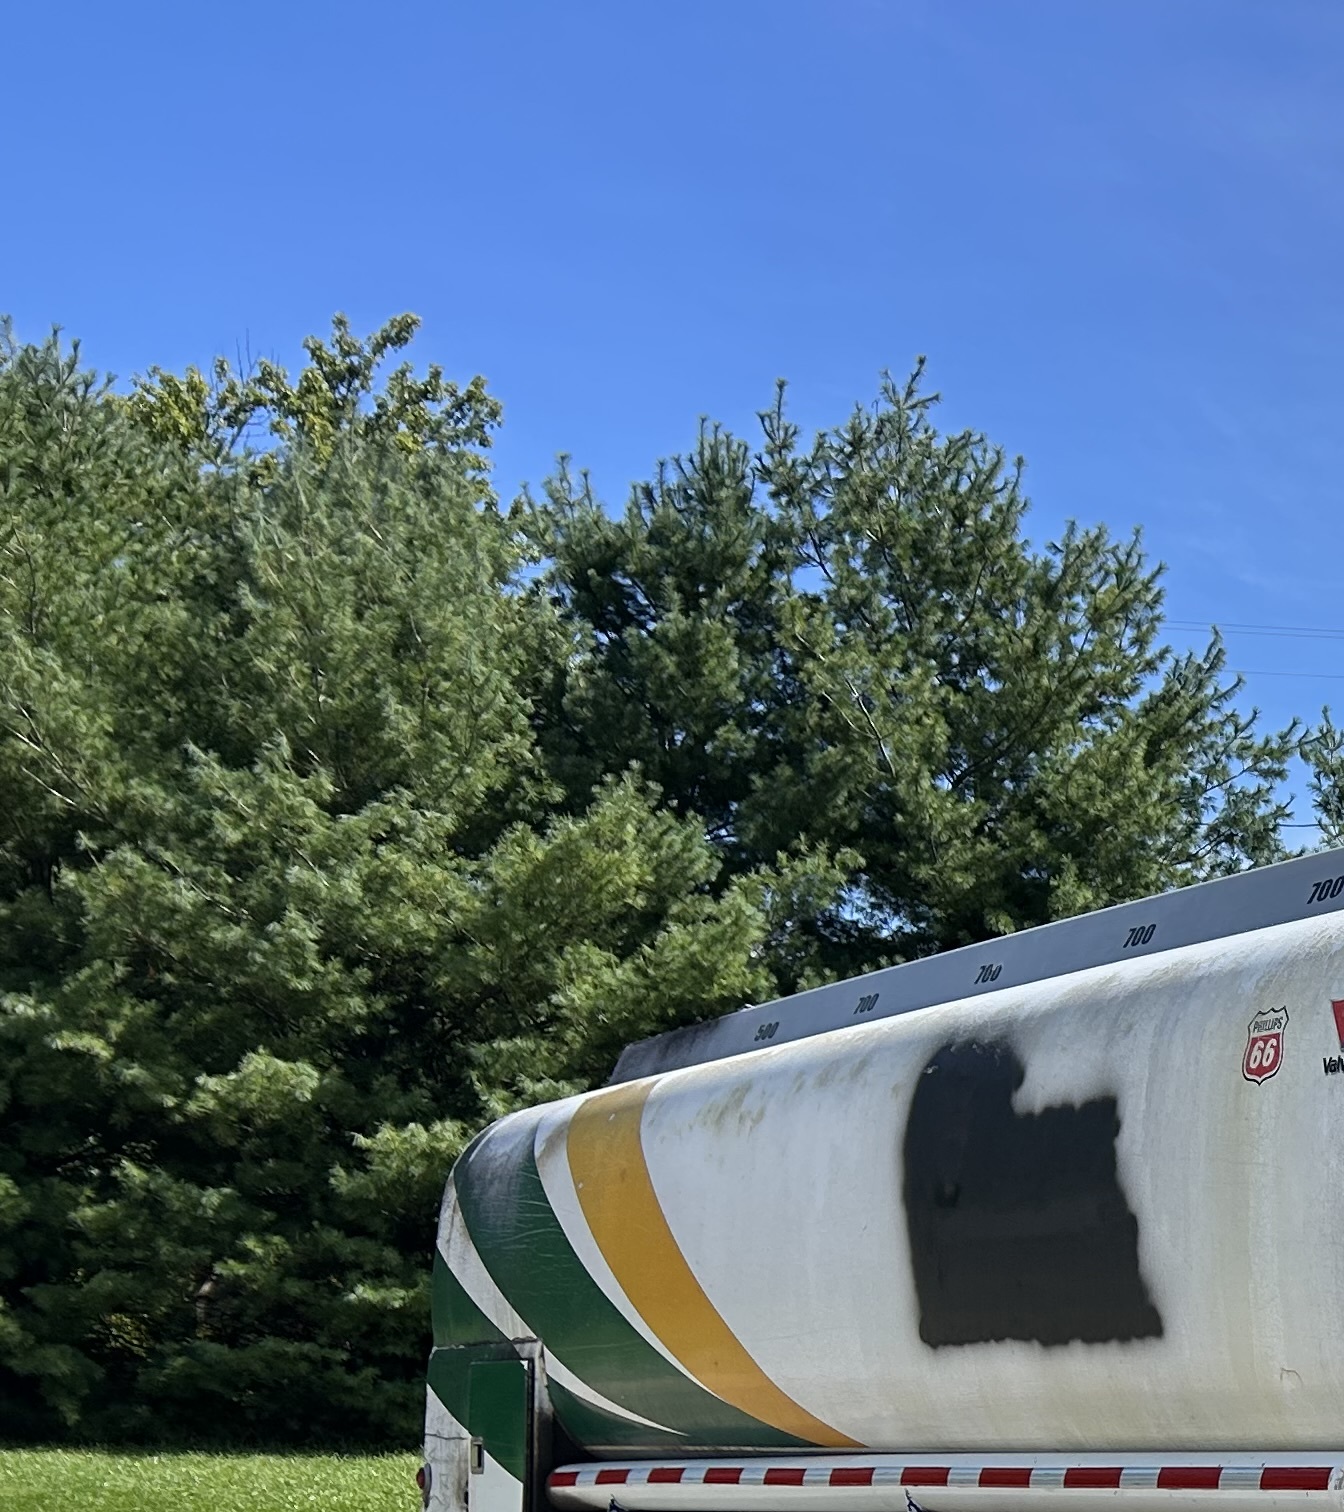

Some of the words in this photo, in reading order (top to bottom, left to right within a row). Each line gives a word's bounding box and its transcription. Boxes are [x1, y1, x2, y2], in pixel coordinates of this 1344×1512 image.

[1122, 923, 1157, 949] 700
[973, 963, 1003, 985] 700
[853, 992, 880, 1015] 700
[753, 1021, 780, 1042] 500
[1252, 1015, 1285, 1034] PHILLIPS
[1249, 1038, 1278, 1069] 66
